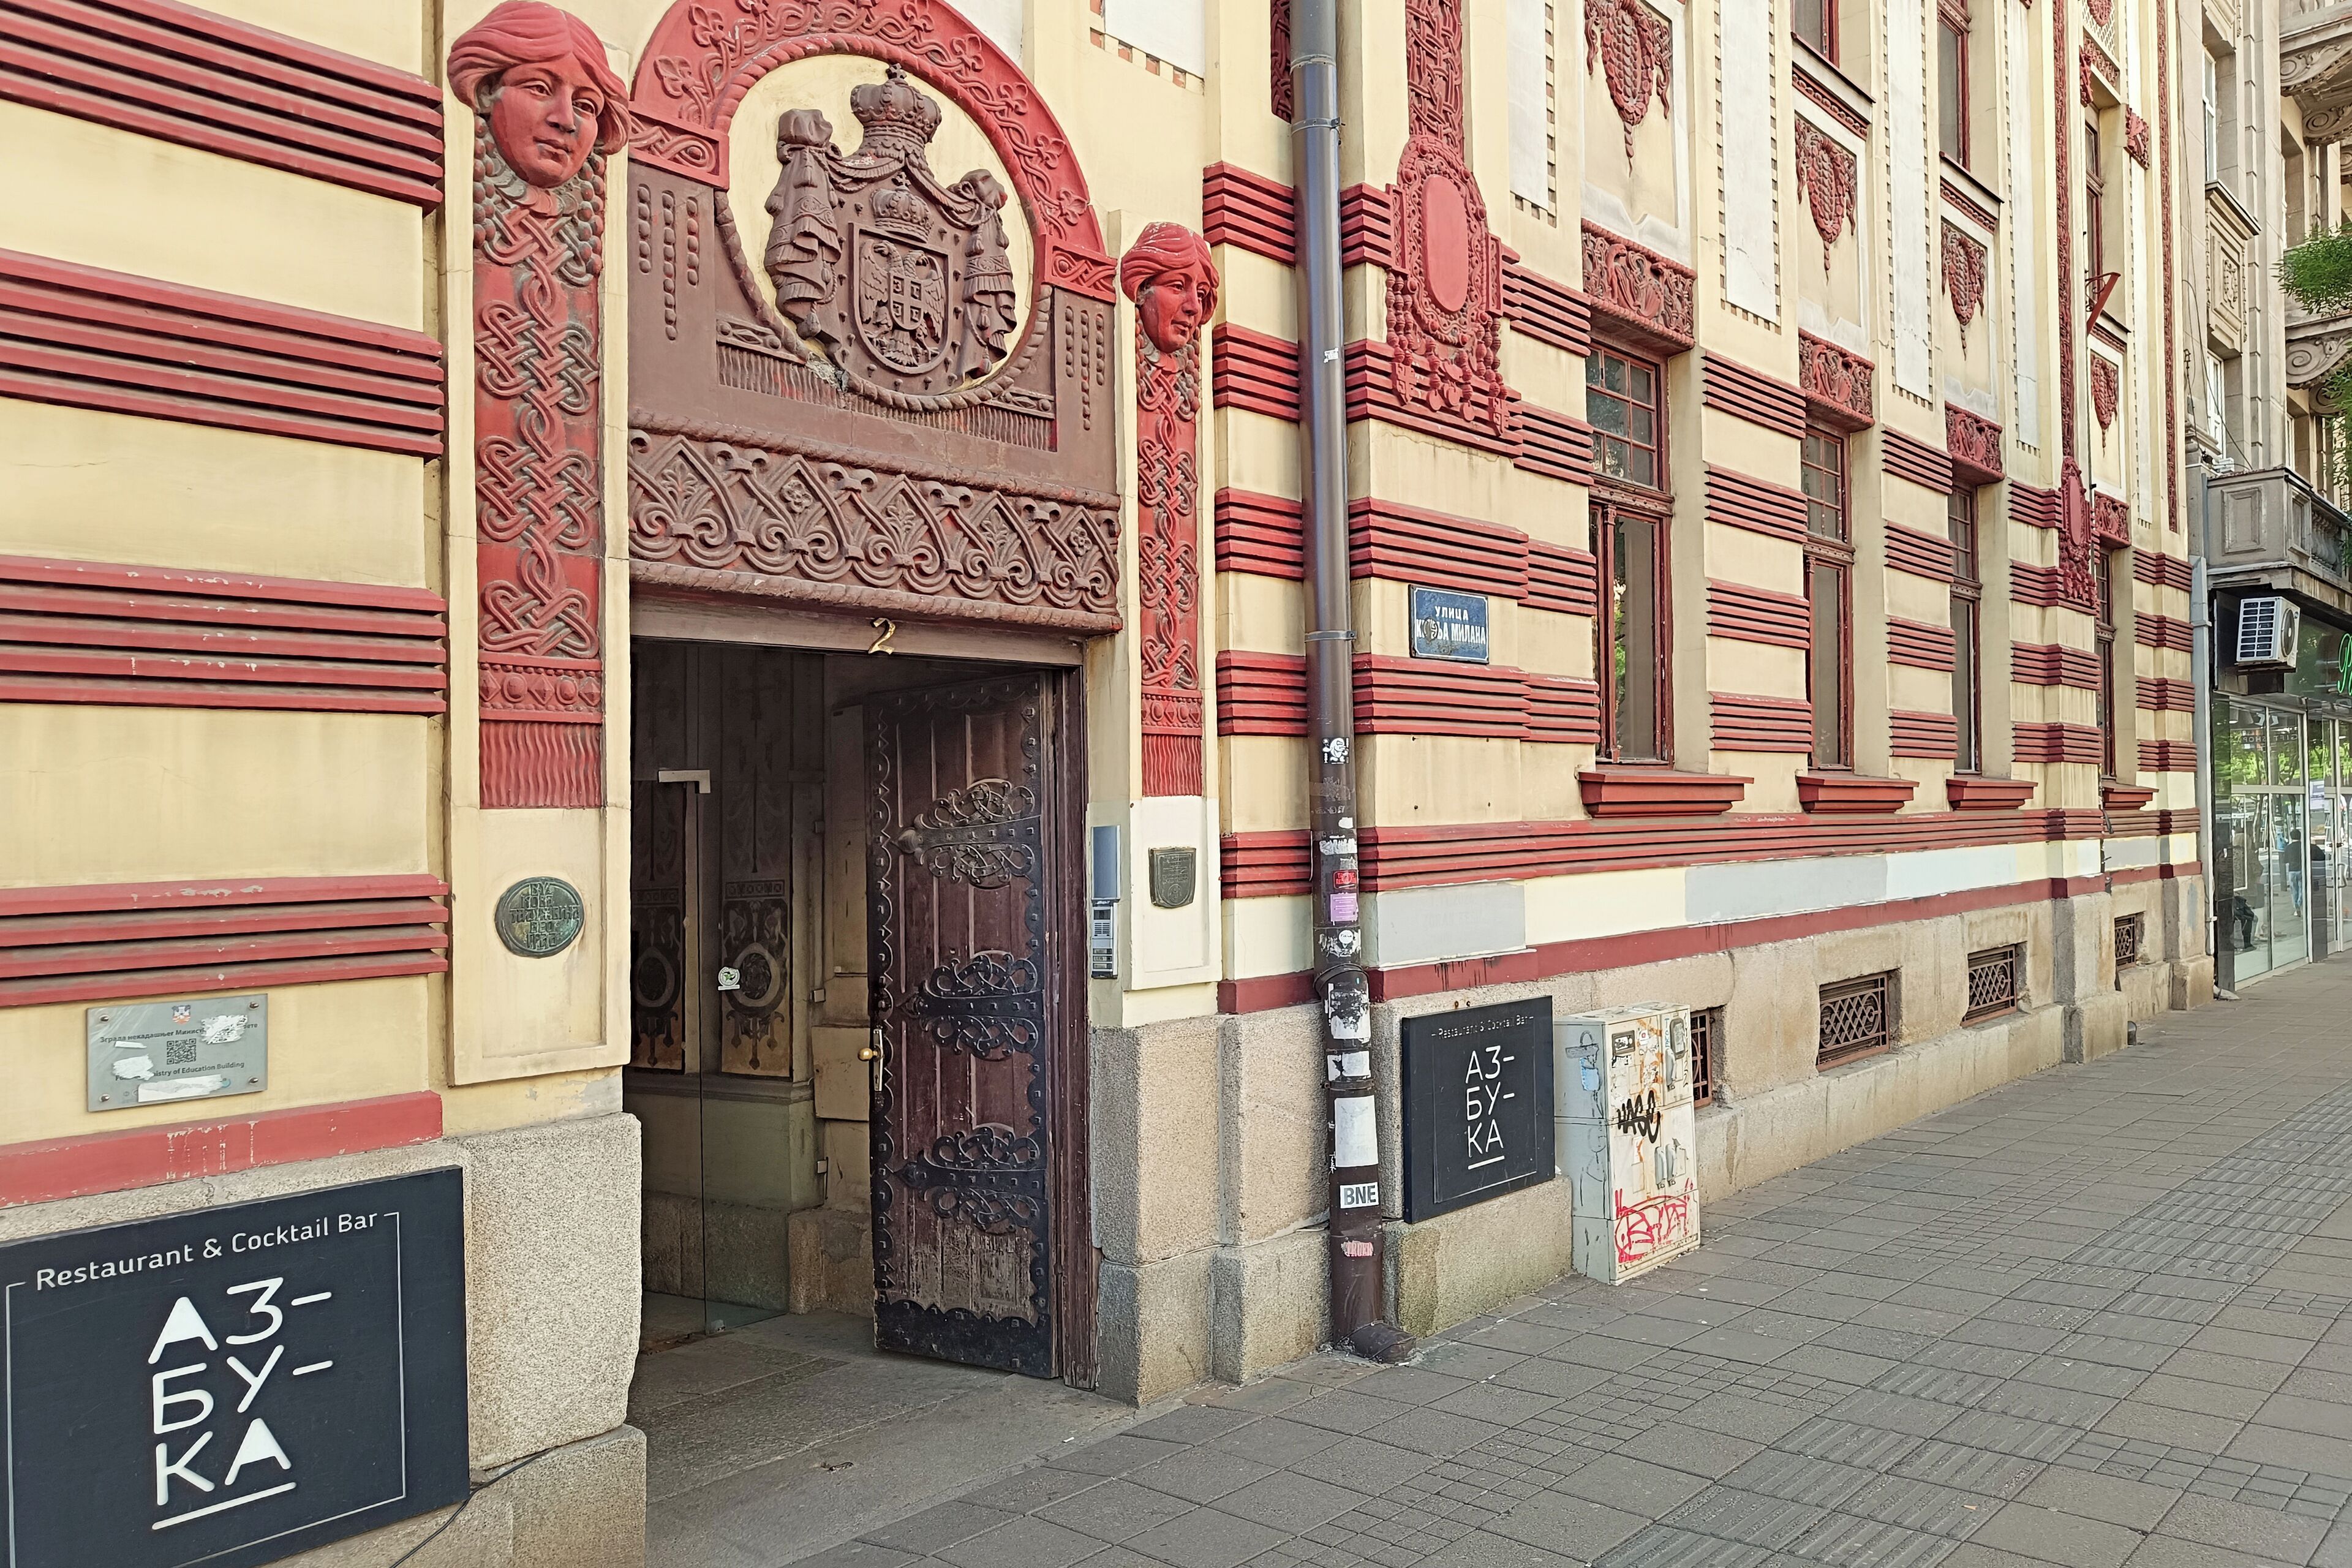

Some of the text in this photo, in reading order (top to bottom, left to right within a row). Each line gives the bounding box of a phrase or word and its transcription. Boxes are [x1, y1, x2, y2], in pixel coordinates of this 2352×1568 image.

[1434, 606, 1469, 621] УЛИЦА
[868, 617, 895, 655] 2
[1451, 623, 1486, 645] МИЛАНА
[181, 1065, 216, 1074] Education
[1468, 1119, 1504, 1158] КА
[1344, 1185, 1376, 1205] BNE
[37, 1212, 377, 1290] Restaurant & Cocktail Bar
[157, 1418, 292, 1505] КА
